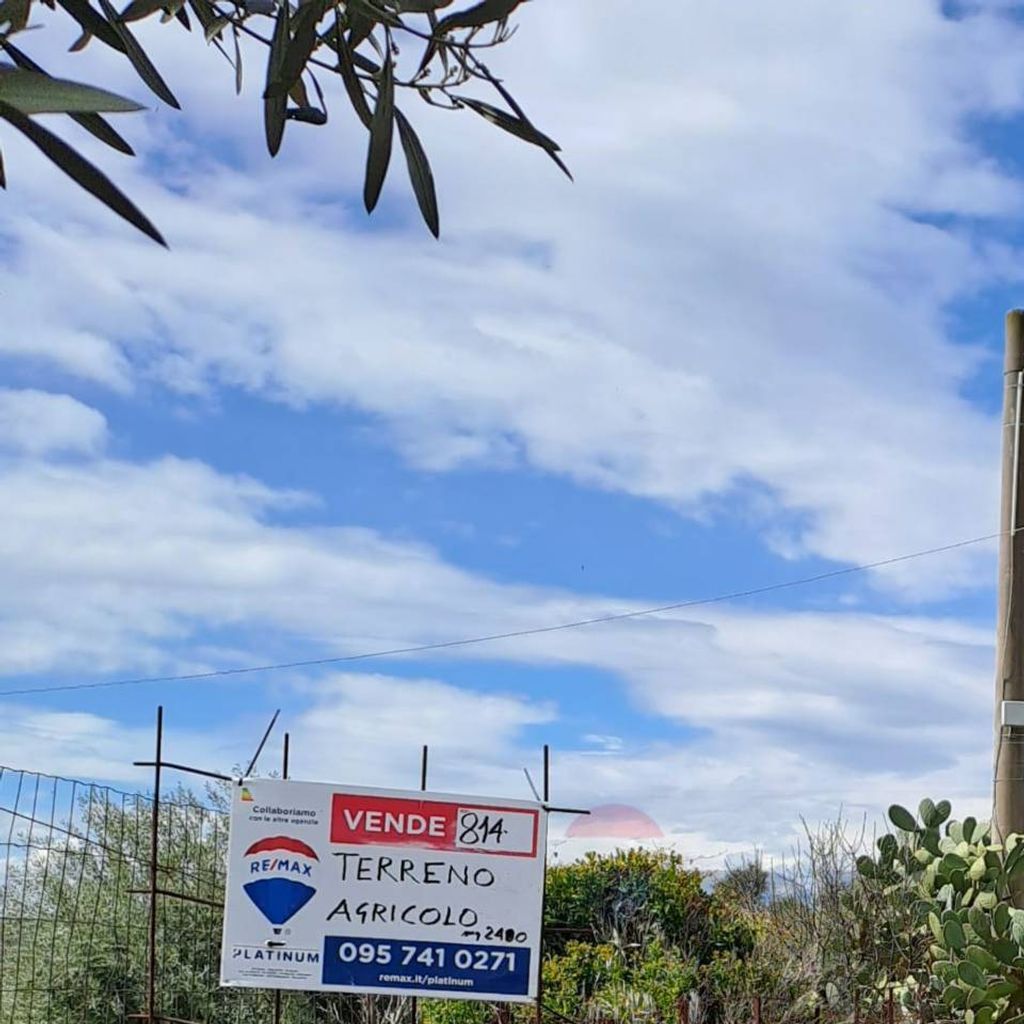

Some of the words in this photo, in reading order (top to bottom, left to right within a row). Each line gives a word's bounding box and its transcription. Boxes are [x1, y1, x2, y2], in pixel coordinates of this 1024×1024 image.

[252, 805, 317, 817] Collaboriamo
[343, 808, 446, 837] VENDE
[250, 859, 313, 877] RE/MAX
[332, 852, 495, 887] TERRENO
[326, 898, 478, 927] AGRICOLO
[339, 942, 392, 964] 095
[401, 946, 445, 968] 741
[454, 949, 516, 972] 0271
[379, 973, 474, 988] remax.it/platinum
